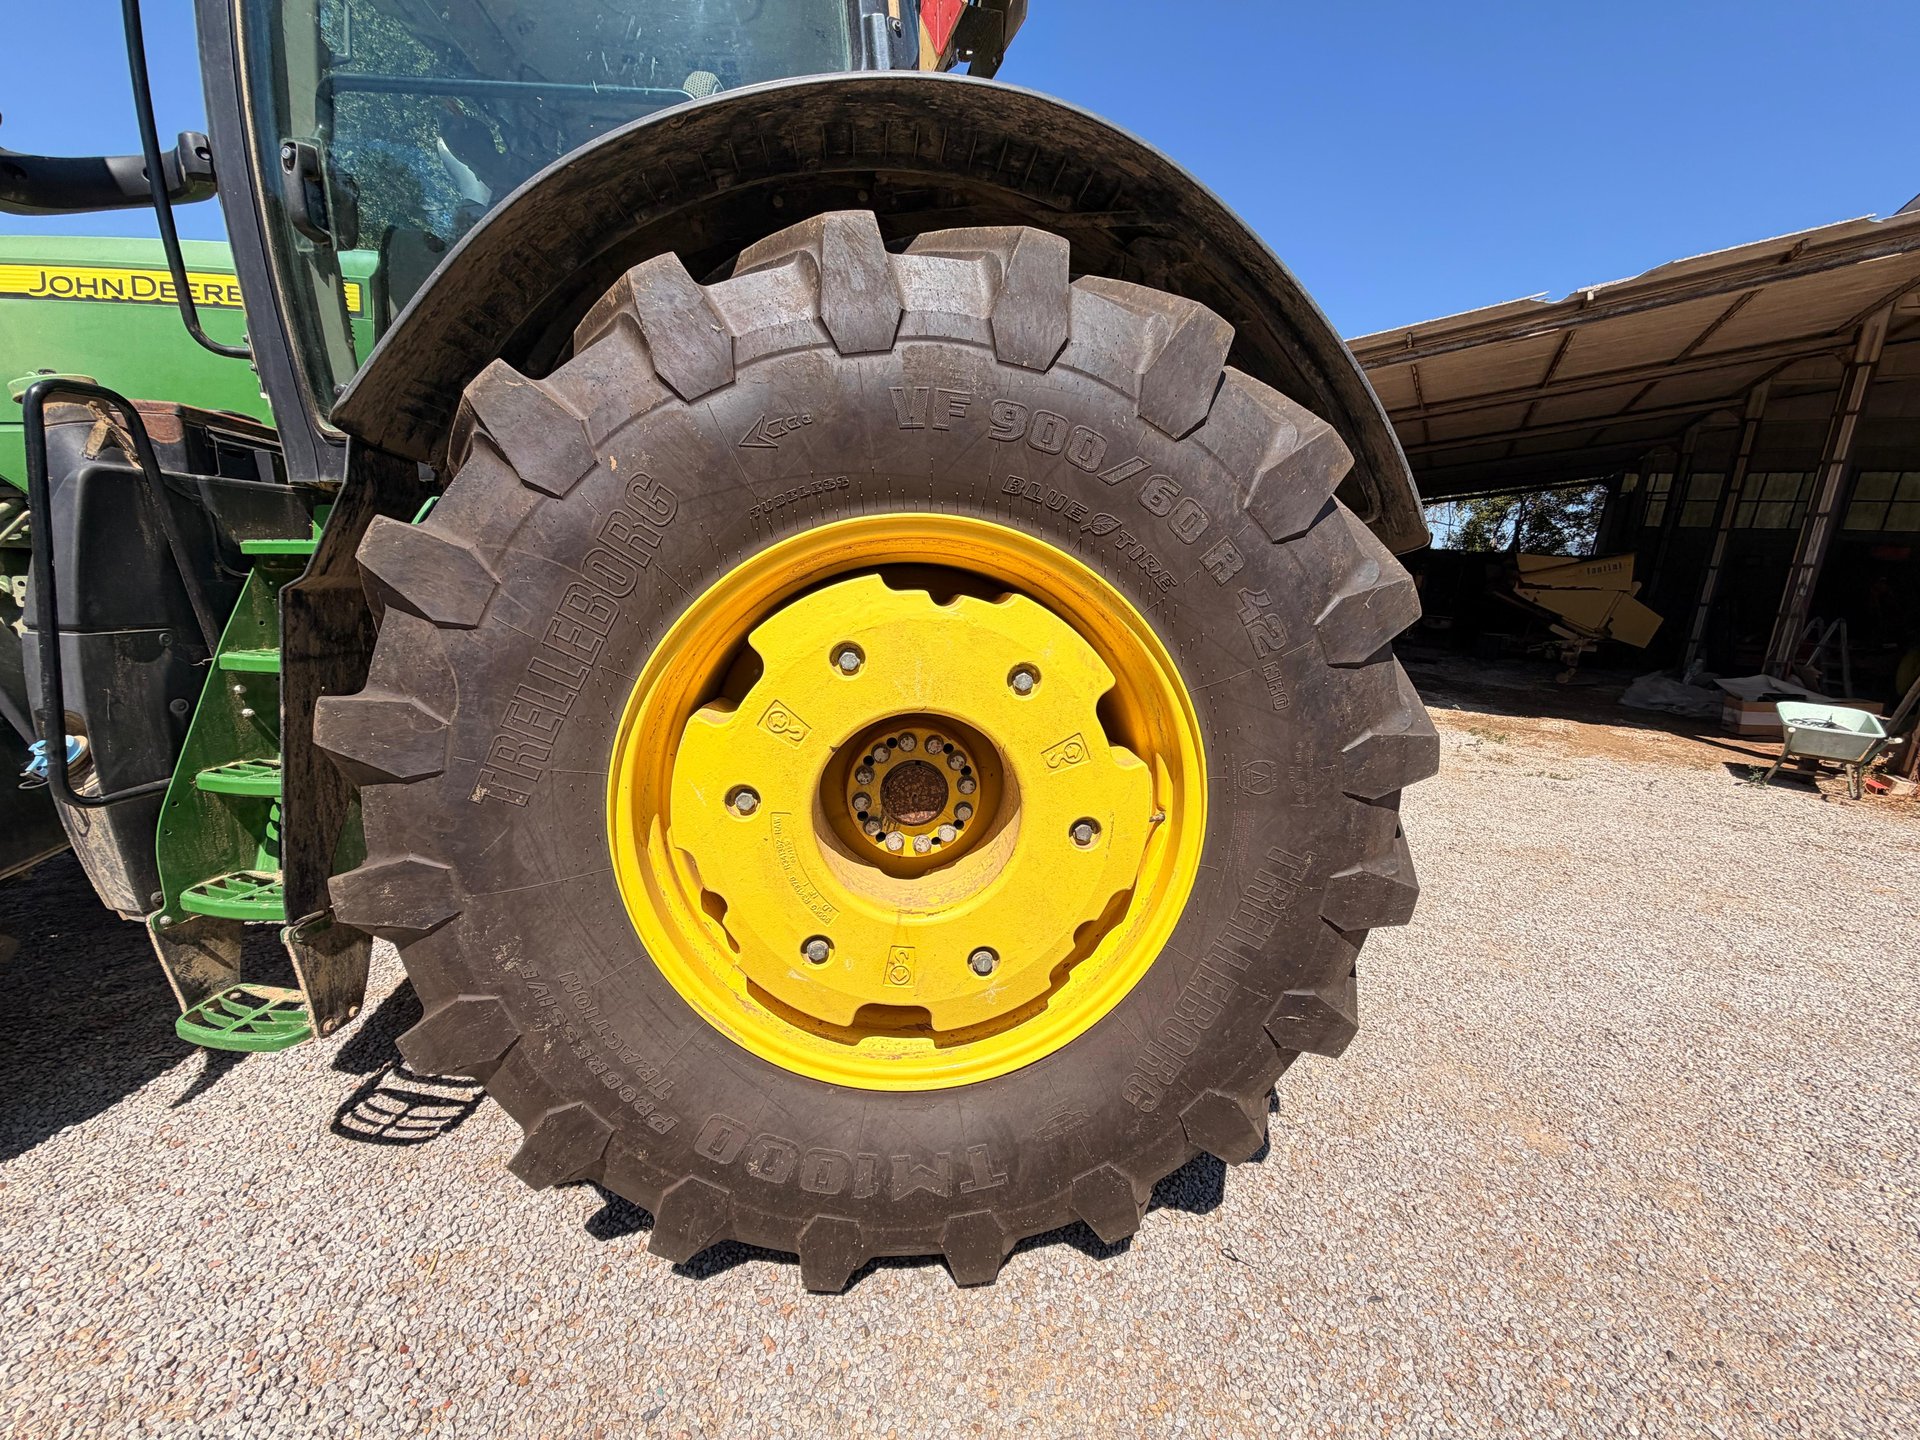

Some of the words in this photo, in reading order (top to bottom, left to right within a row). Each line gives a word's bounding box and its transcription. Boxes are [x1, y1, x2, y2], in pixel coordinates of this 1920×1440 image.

[28, 270, 127, 298] JOHN
[750, 475, 850, 518] TUBELESS
[889, 386, 971, 431] VF
[988, 399, 1209, 545] 900/60
[1199, 535, 1245, 587] R
[1237, 587, 1288, 660] 42
[1001, 475, 1088, 523] BLUE
[1115, 530, 1178, 593] TIRE
[467, 471, 679, 808] TRELLEBORG
[558, 971, 674, 1101] TRACTION
[1121, 846, 1318, 1113] TRELLEBORG
[520, 959, 679, 1135] PROGRESSIVE
[692, 1111, 1009, 1201] TM1000
